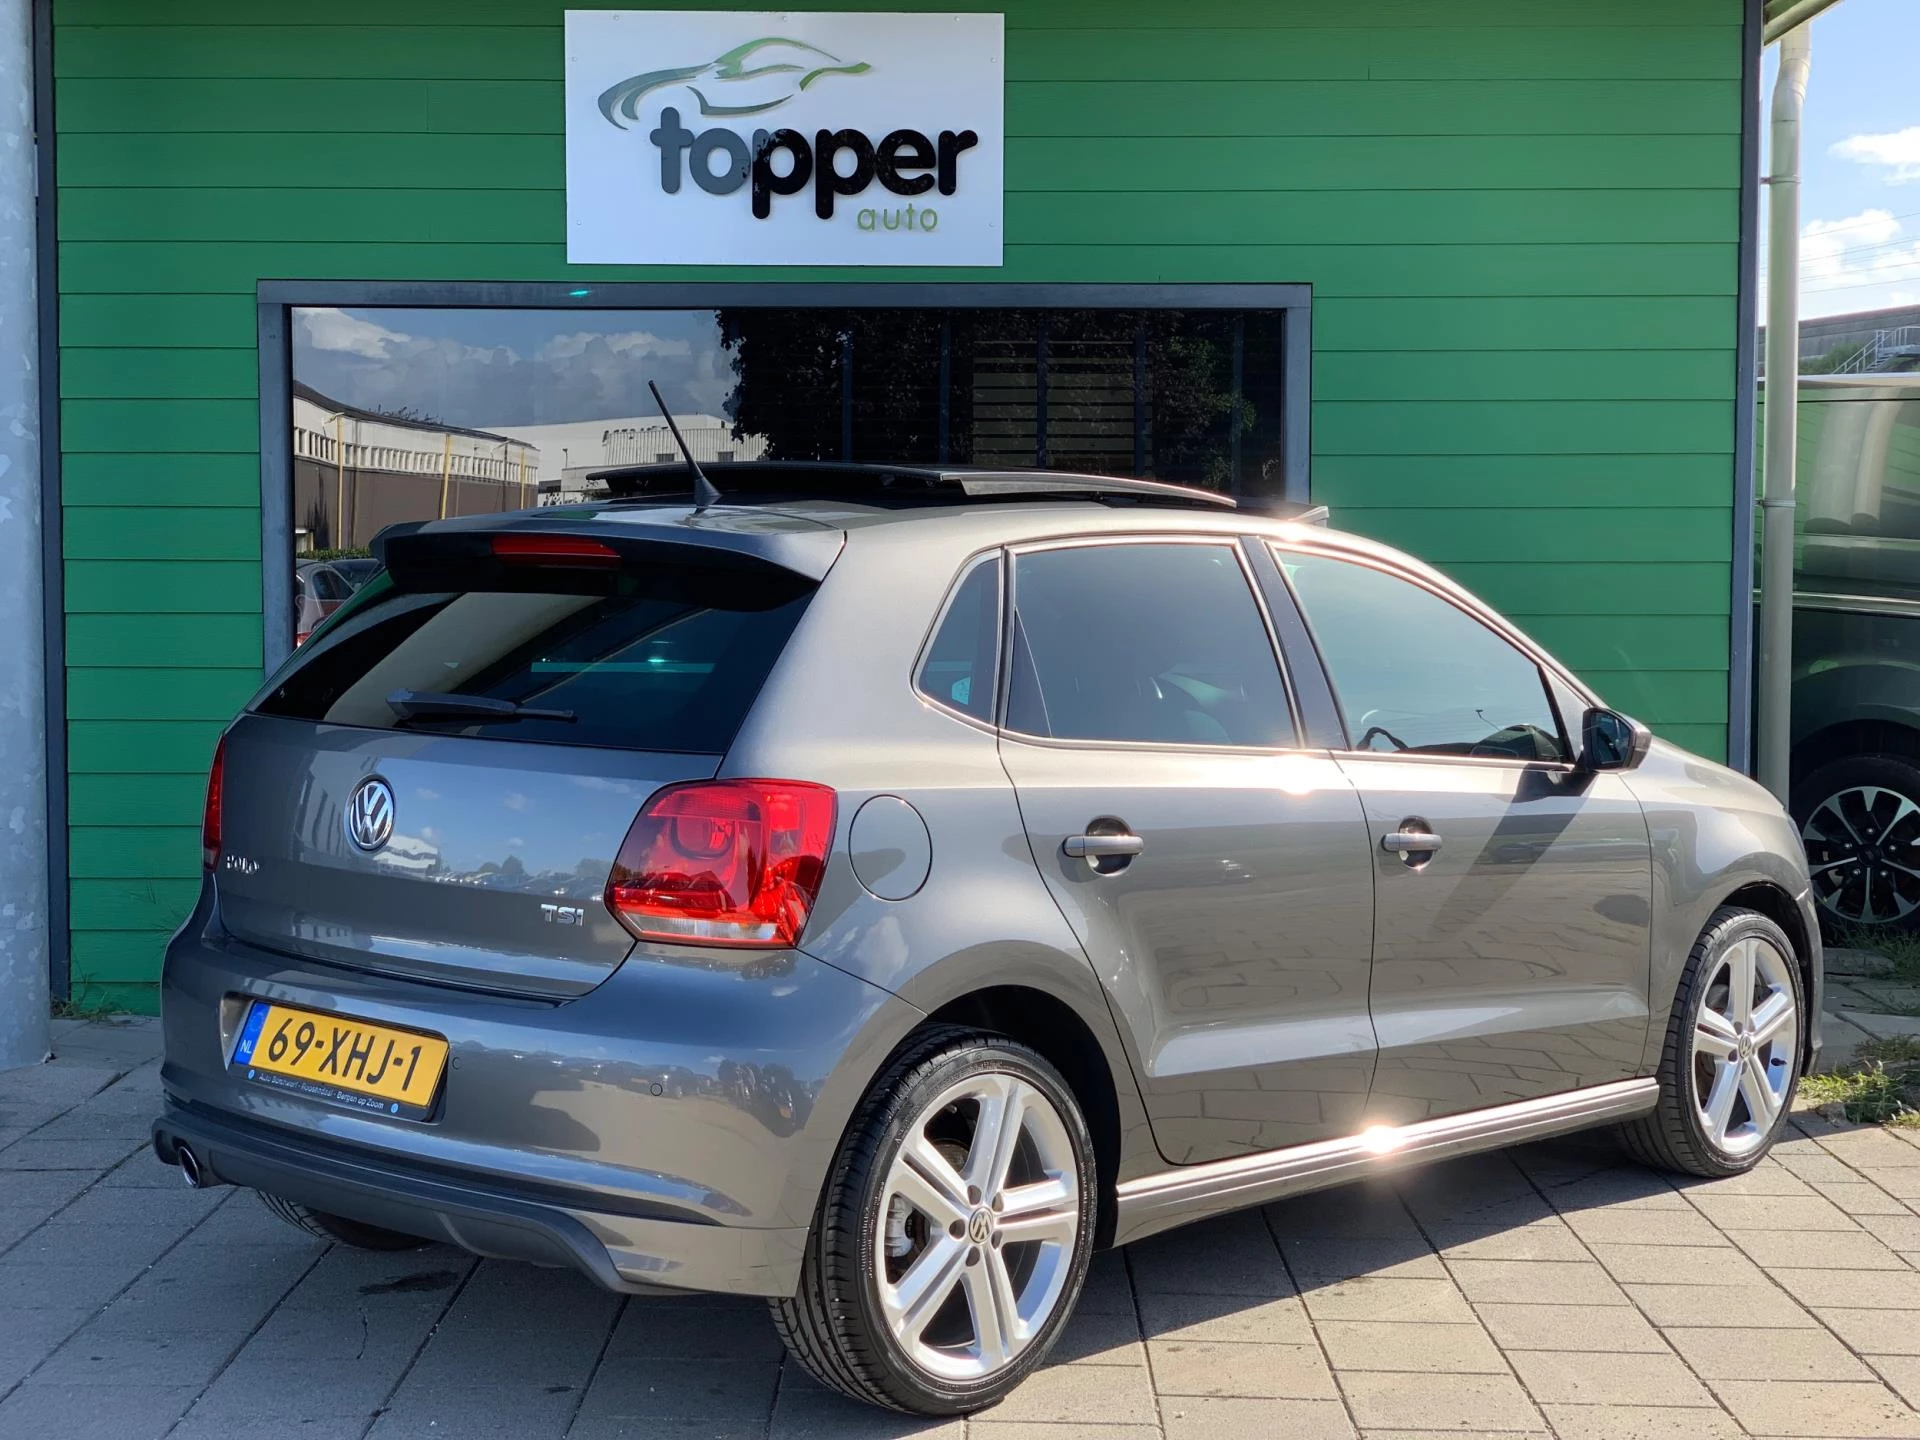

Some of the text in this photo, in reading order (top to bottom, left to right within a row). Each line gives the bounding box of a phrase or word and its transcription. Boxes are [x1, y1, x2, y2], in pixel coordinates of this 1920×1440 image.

[650, 106, 979, 220] topper
[856, 203, 938, 232] auto
[541, 903, 584, 926] TSI
[240, 1039, 252, 1054] NL
[268, 1017, 422, 1092] 69-XHJ-1
